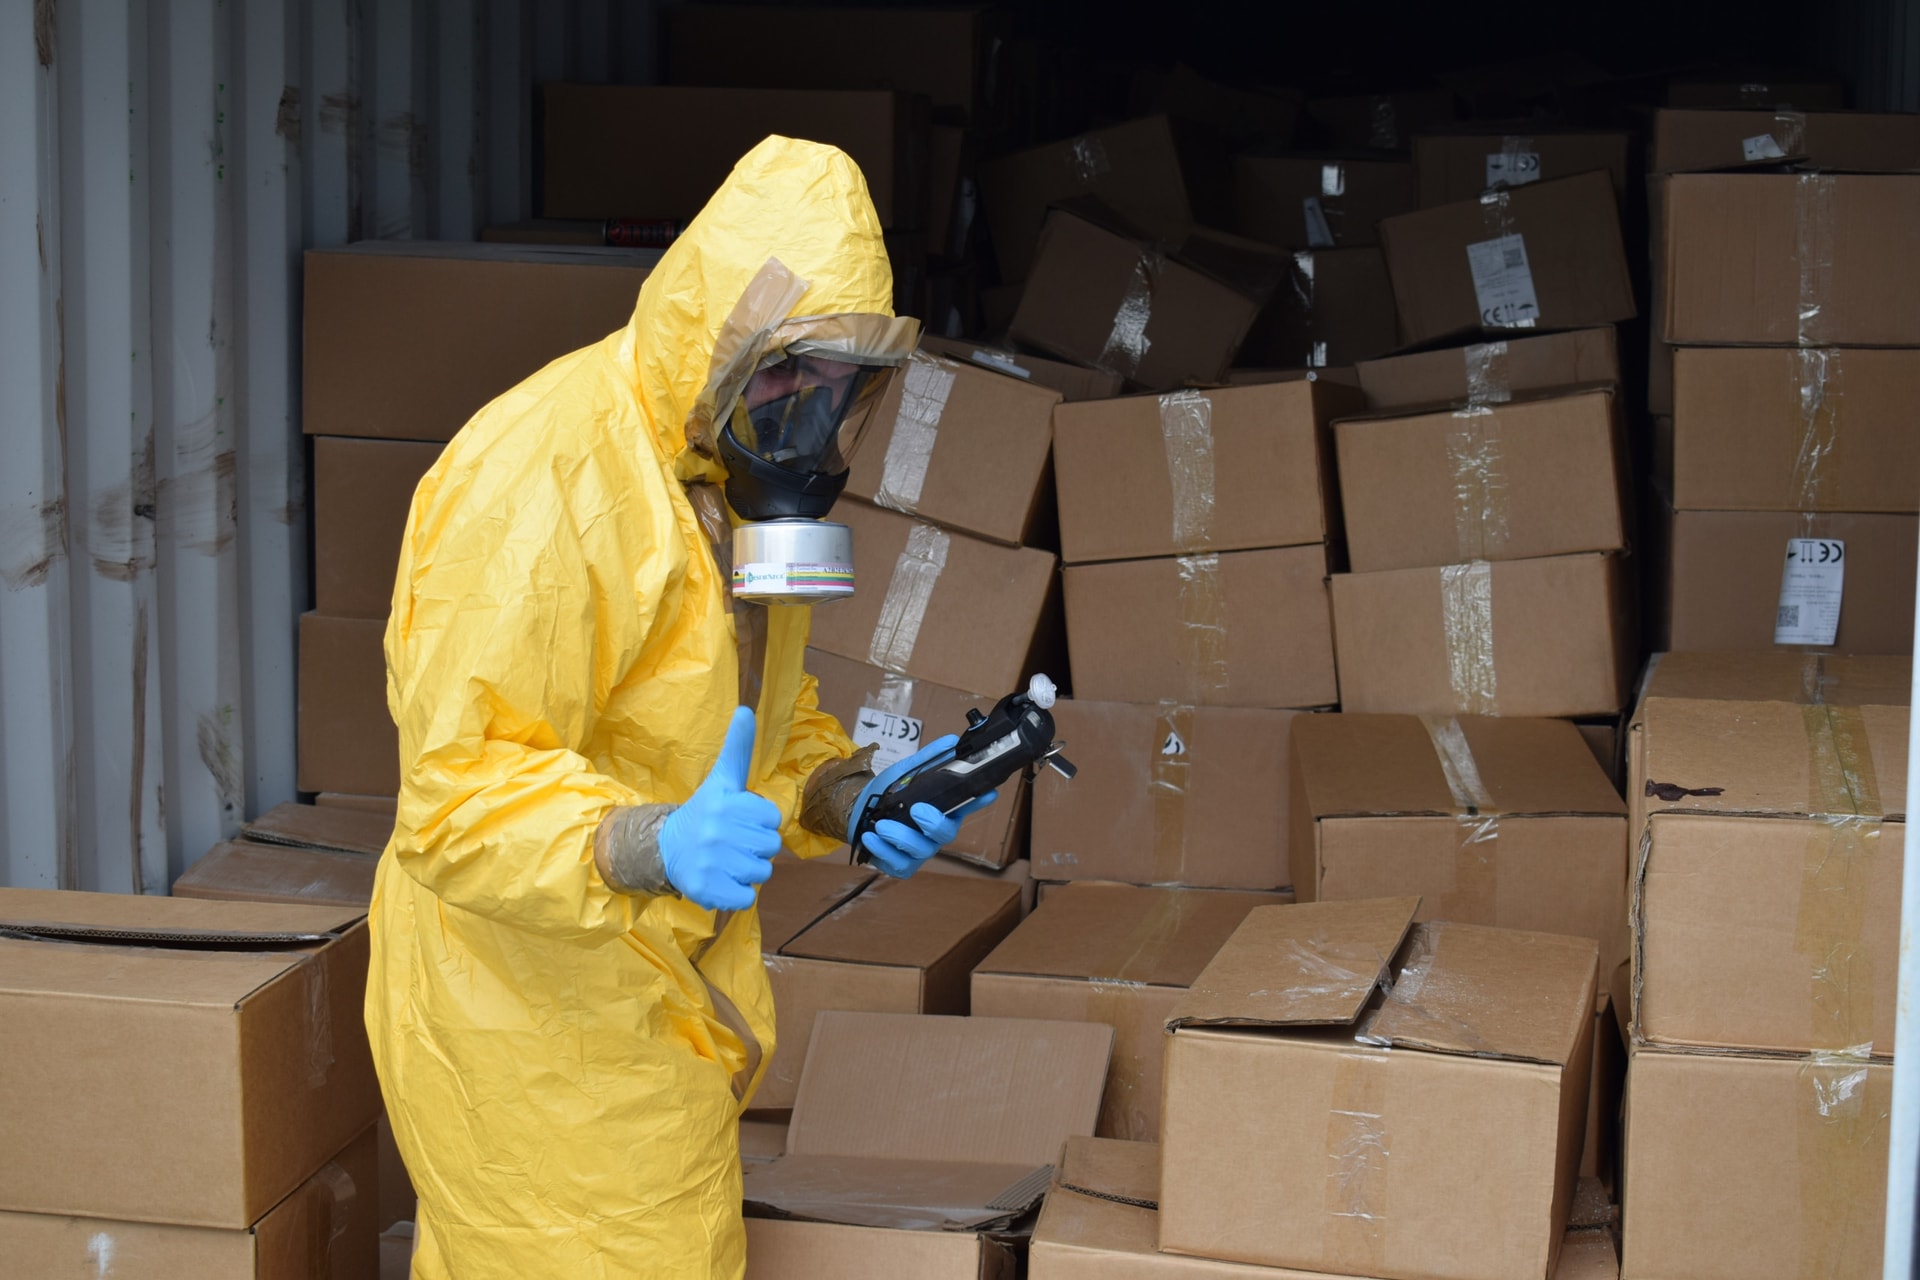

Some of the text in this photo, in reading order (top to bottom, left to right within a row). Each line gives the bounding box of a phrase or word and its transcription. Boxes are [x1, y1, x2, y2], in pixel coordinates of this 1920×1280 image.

[1483, 306, 1503, 326] CE
[1818, 542, 1842, 563] CE
[898, 719, 920, 742] CE
